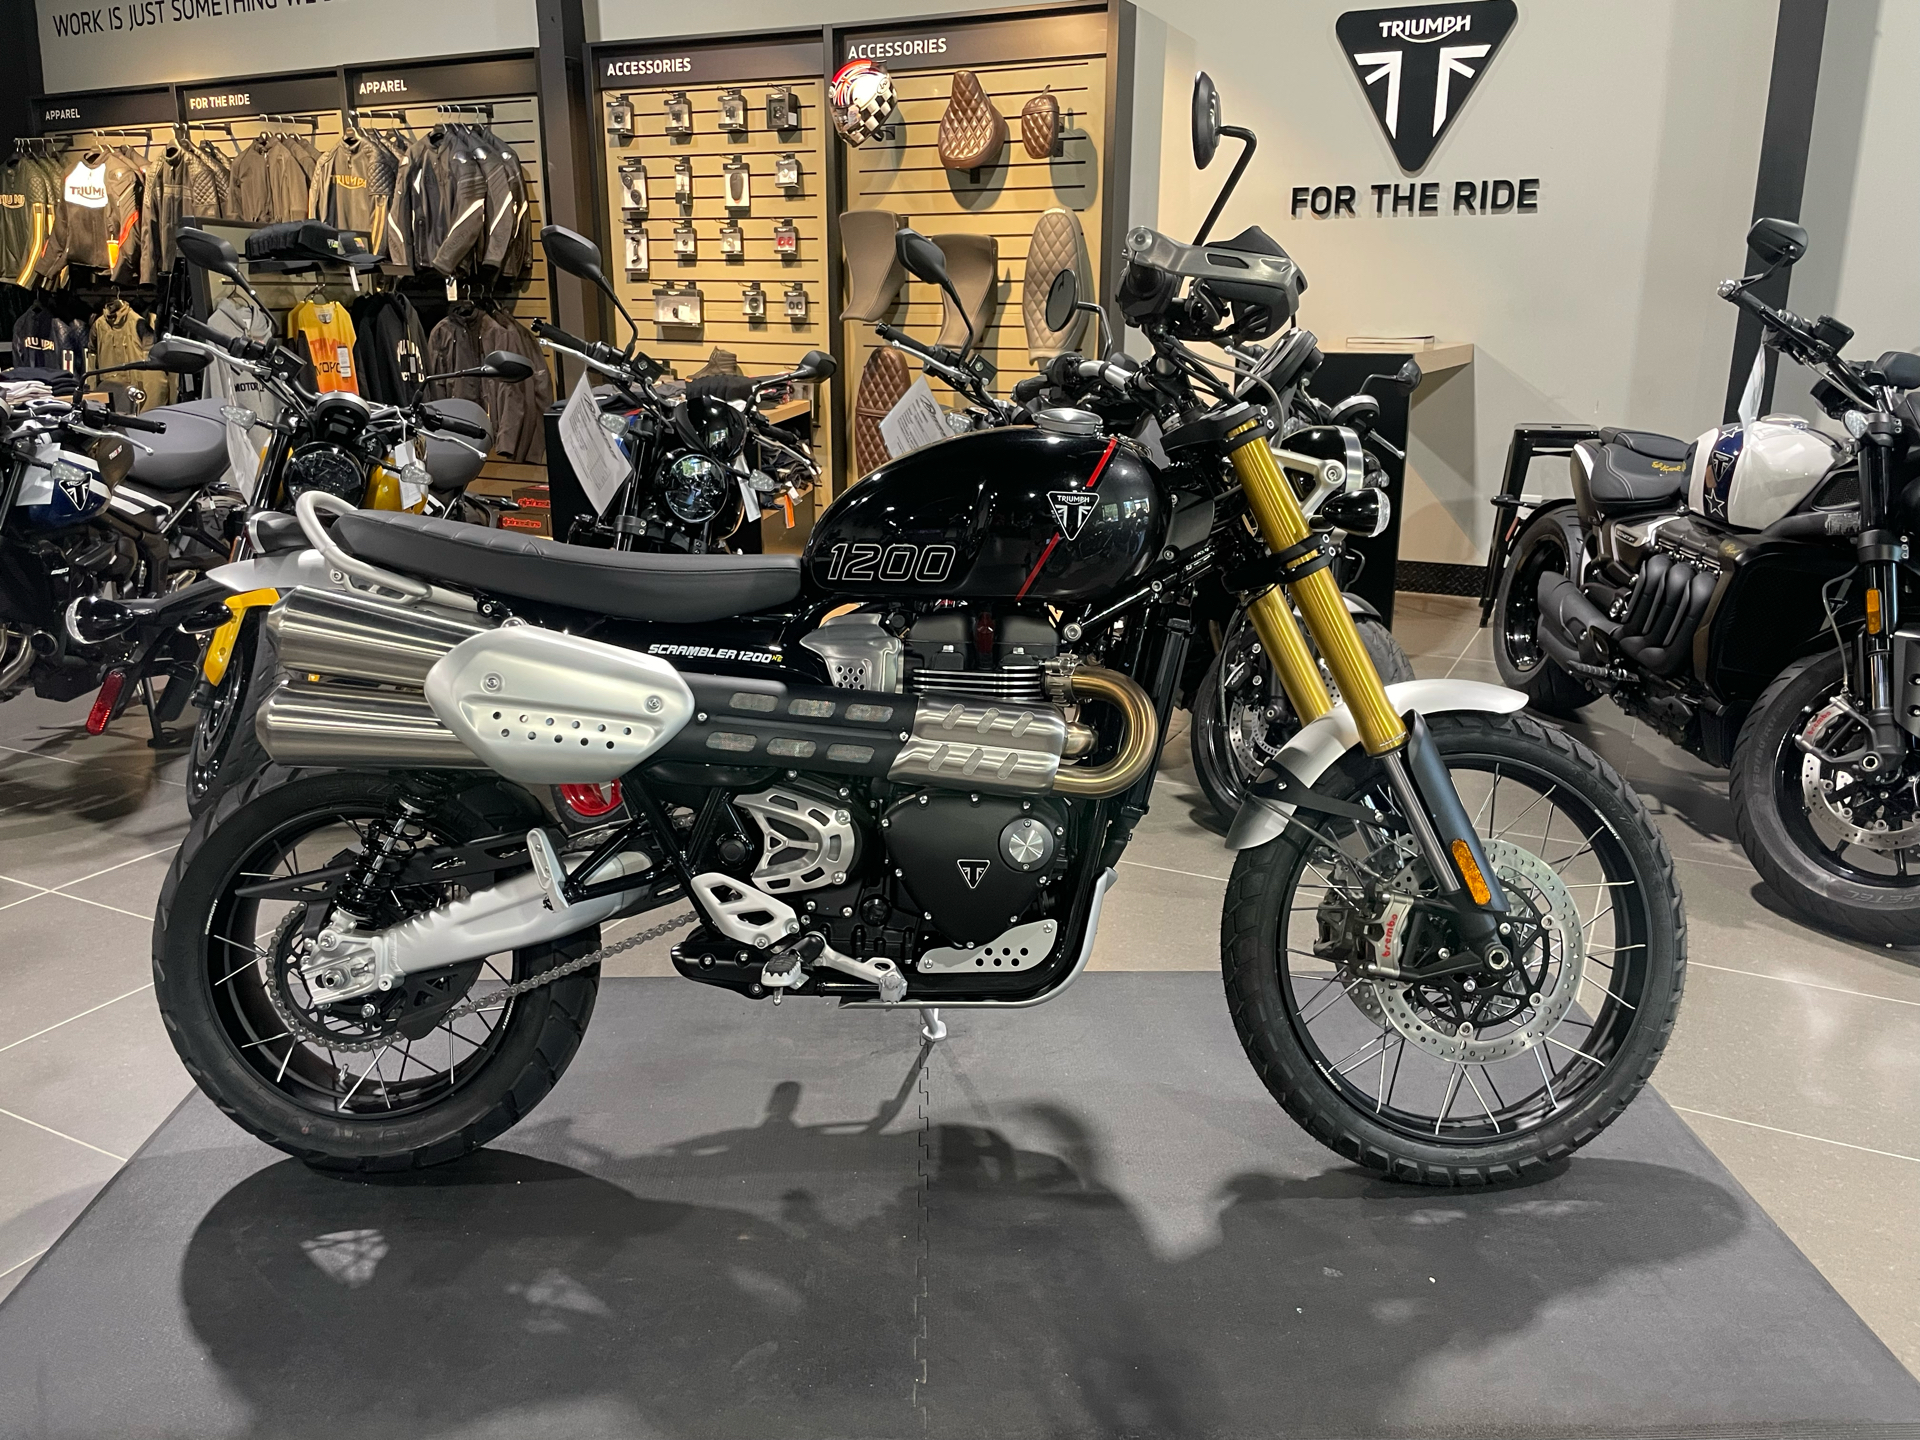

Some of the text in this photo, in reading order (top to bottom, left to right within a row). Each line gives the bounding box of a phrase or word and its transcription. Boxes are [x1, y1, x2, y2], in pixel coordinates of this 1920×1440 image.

[53, 10, 104, 37] WORK
[109, 7, 123, 30] IS
[129, 0, 165, 31] JUST
[1379, 15, 1472, 43] TRIUMPH
[848, 38, 947, 59] ACCESSORIES
[607, 57, 692, 76] ACCESSORIES
[359, 80, 408, 95] APPAREL
[190, 93, 251, 110] FOR THE RIDE
[45, 108, 81, 121] APPAREL
[1291, 178, 1540, 220] FOR THE RIDE
[1057, 495, 1090, 505] TRIUMPH
[827, 543, 956, 582] 1200
[647, 643, 737, 660] SCRAMBLER
[738, 651, 773, 663] 1200
[1807, 711, 1831, 735] brembo
[1382, 913, 1398, 958] brembo
